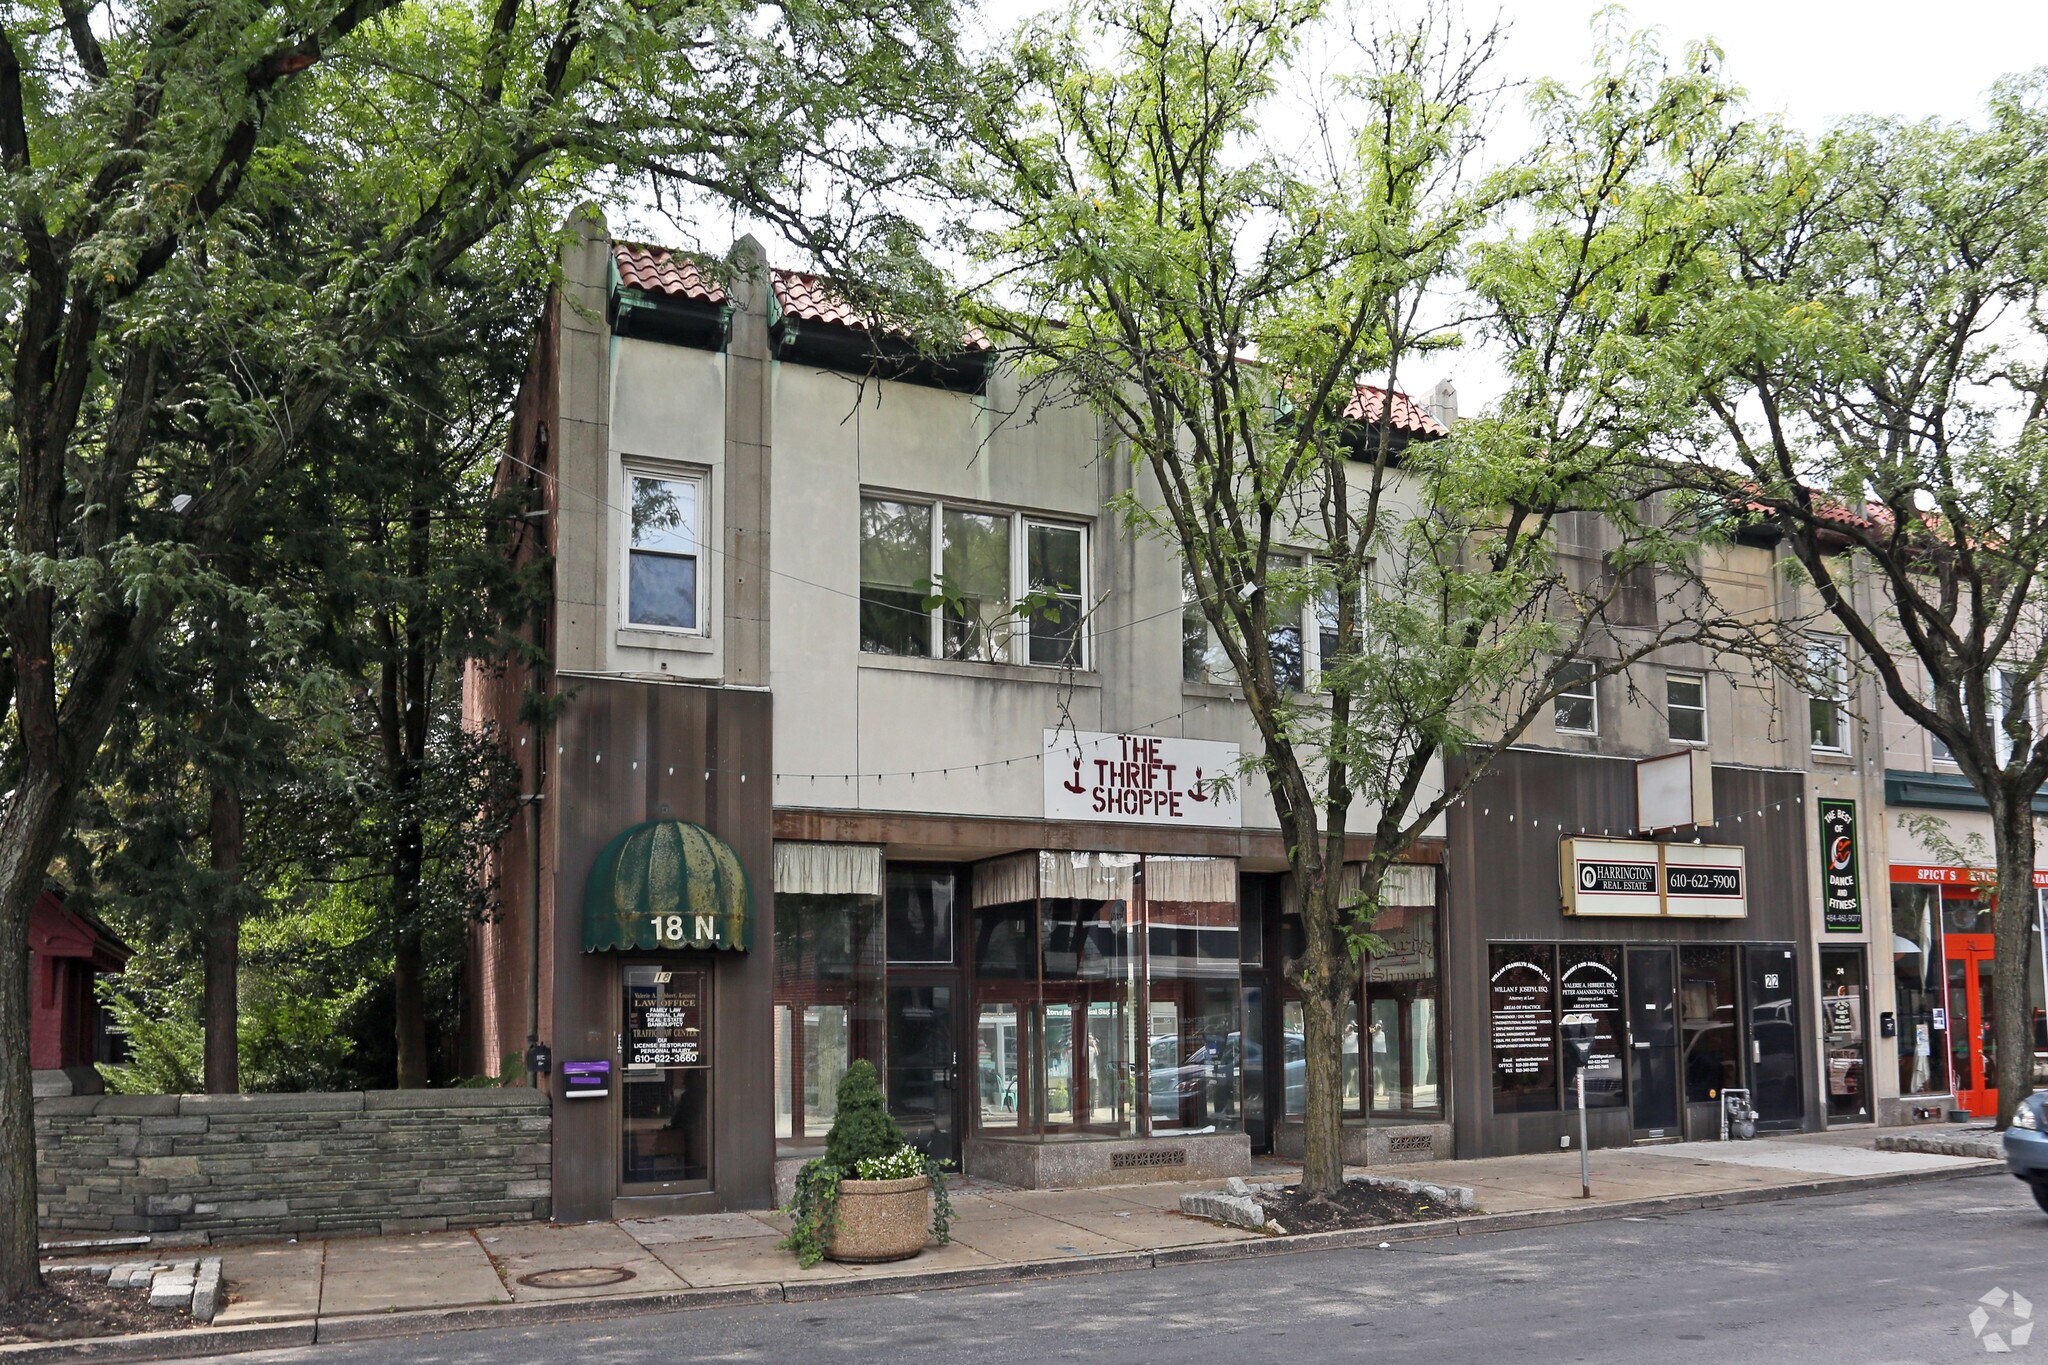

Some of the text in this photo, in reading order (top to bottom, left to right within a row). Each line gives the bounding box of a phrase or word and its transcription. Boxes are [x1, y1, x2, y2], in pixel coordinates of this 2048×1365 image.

[1118, 736, 1162, 764] THE
[1094, 760, 1176, 790] THRIFT
[1092, 786, 1182, 817] SHOPPE
[1824, 810, 1852, 824] THE BEST
[1597, 866, 1736, 889] HARRINGTON 610-622-5900
[1830, 875, 1854, 886] DANCE
[1603, 880, 1647, 891] REAL ESTATE
[1829, 898, 1856, 909] FITNESS
[651, 915, 720, 940] 18 N.
[657, 972, 670, 981] 18
[1766, 974, 1778, 988] 22
[633, 1029, 656, 1037] TRAFFIC
